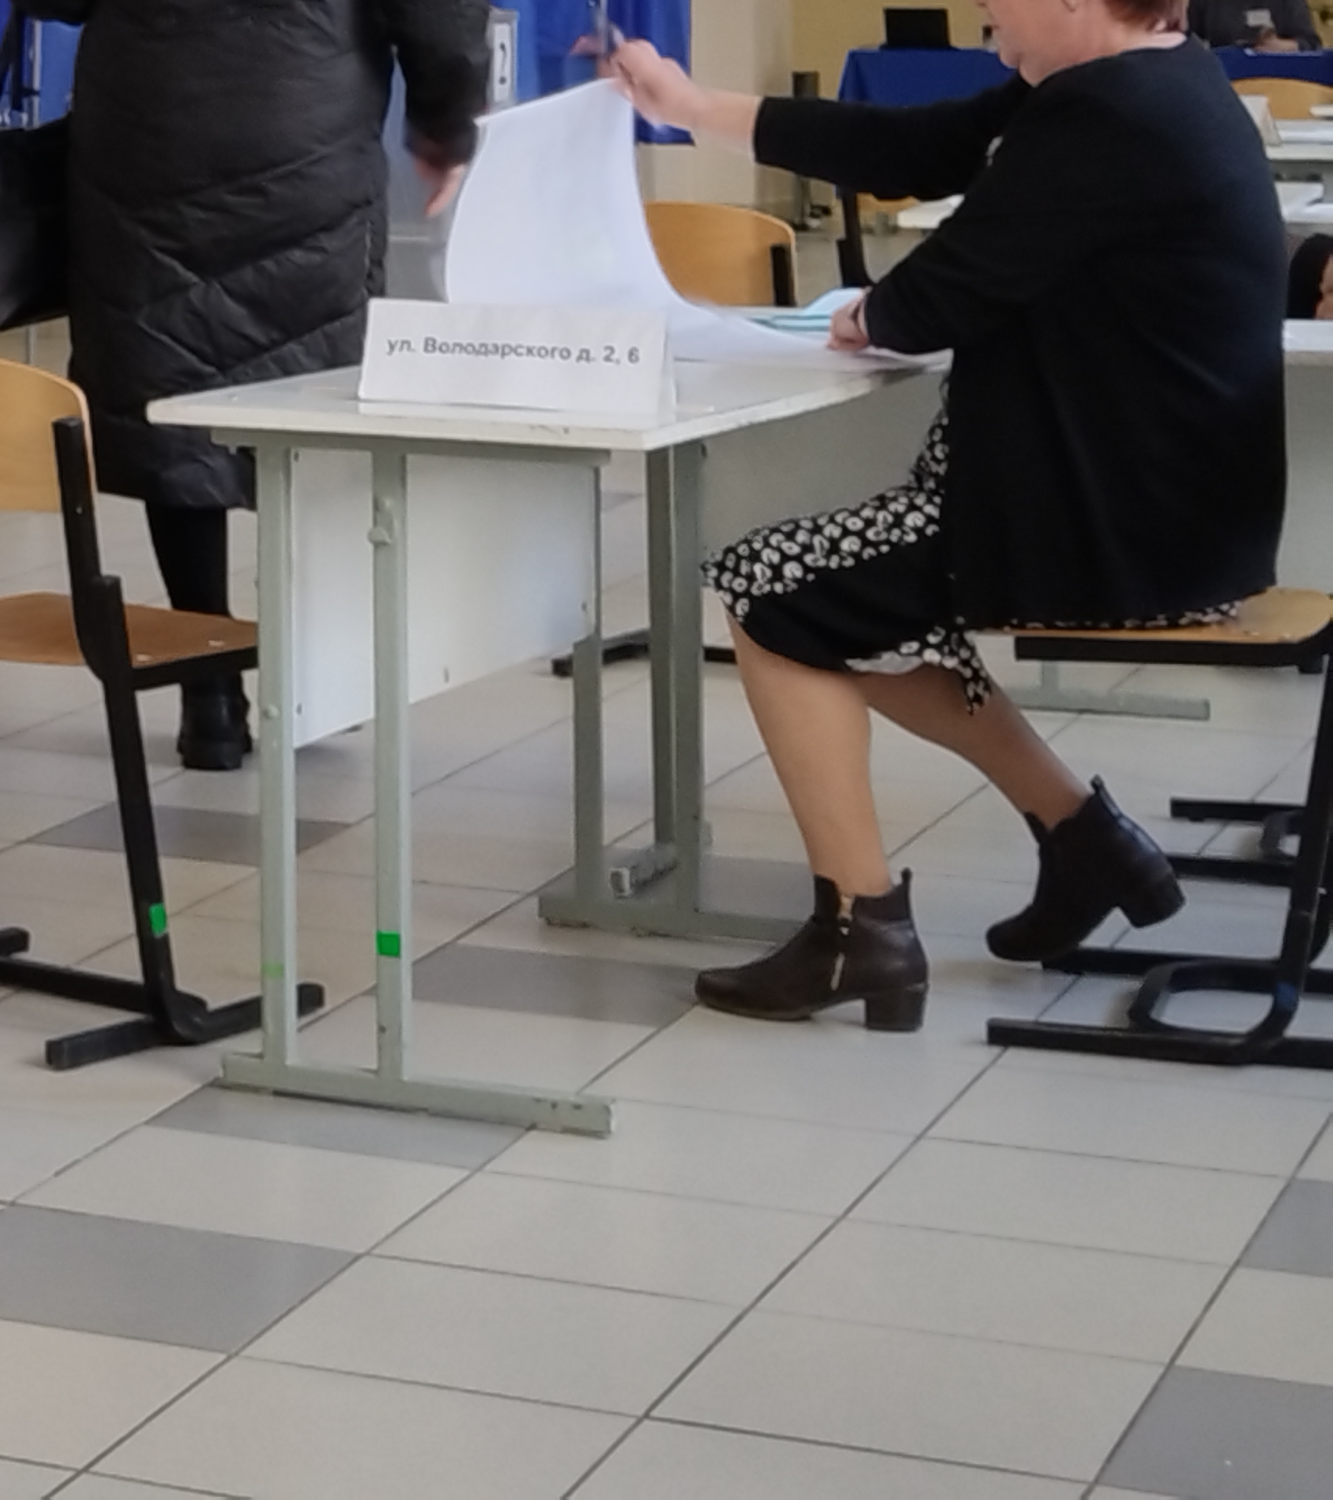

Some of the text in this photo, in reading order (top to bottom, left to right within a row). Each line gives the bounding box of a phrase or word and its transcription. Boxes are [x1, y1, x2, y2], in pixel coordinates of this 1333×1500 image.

[386, 336, 641, 366] ул. Володарского д. 2, 6
